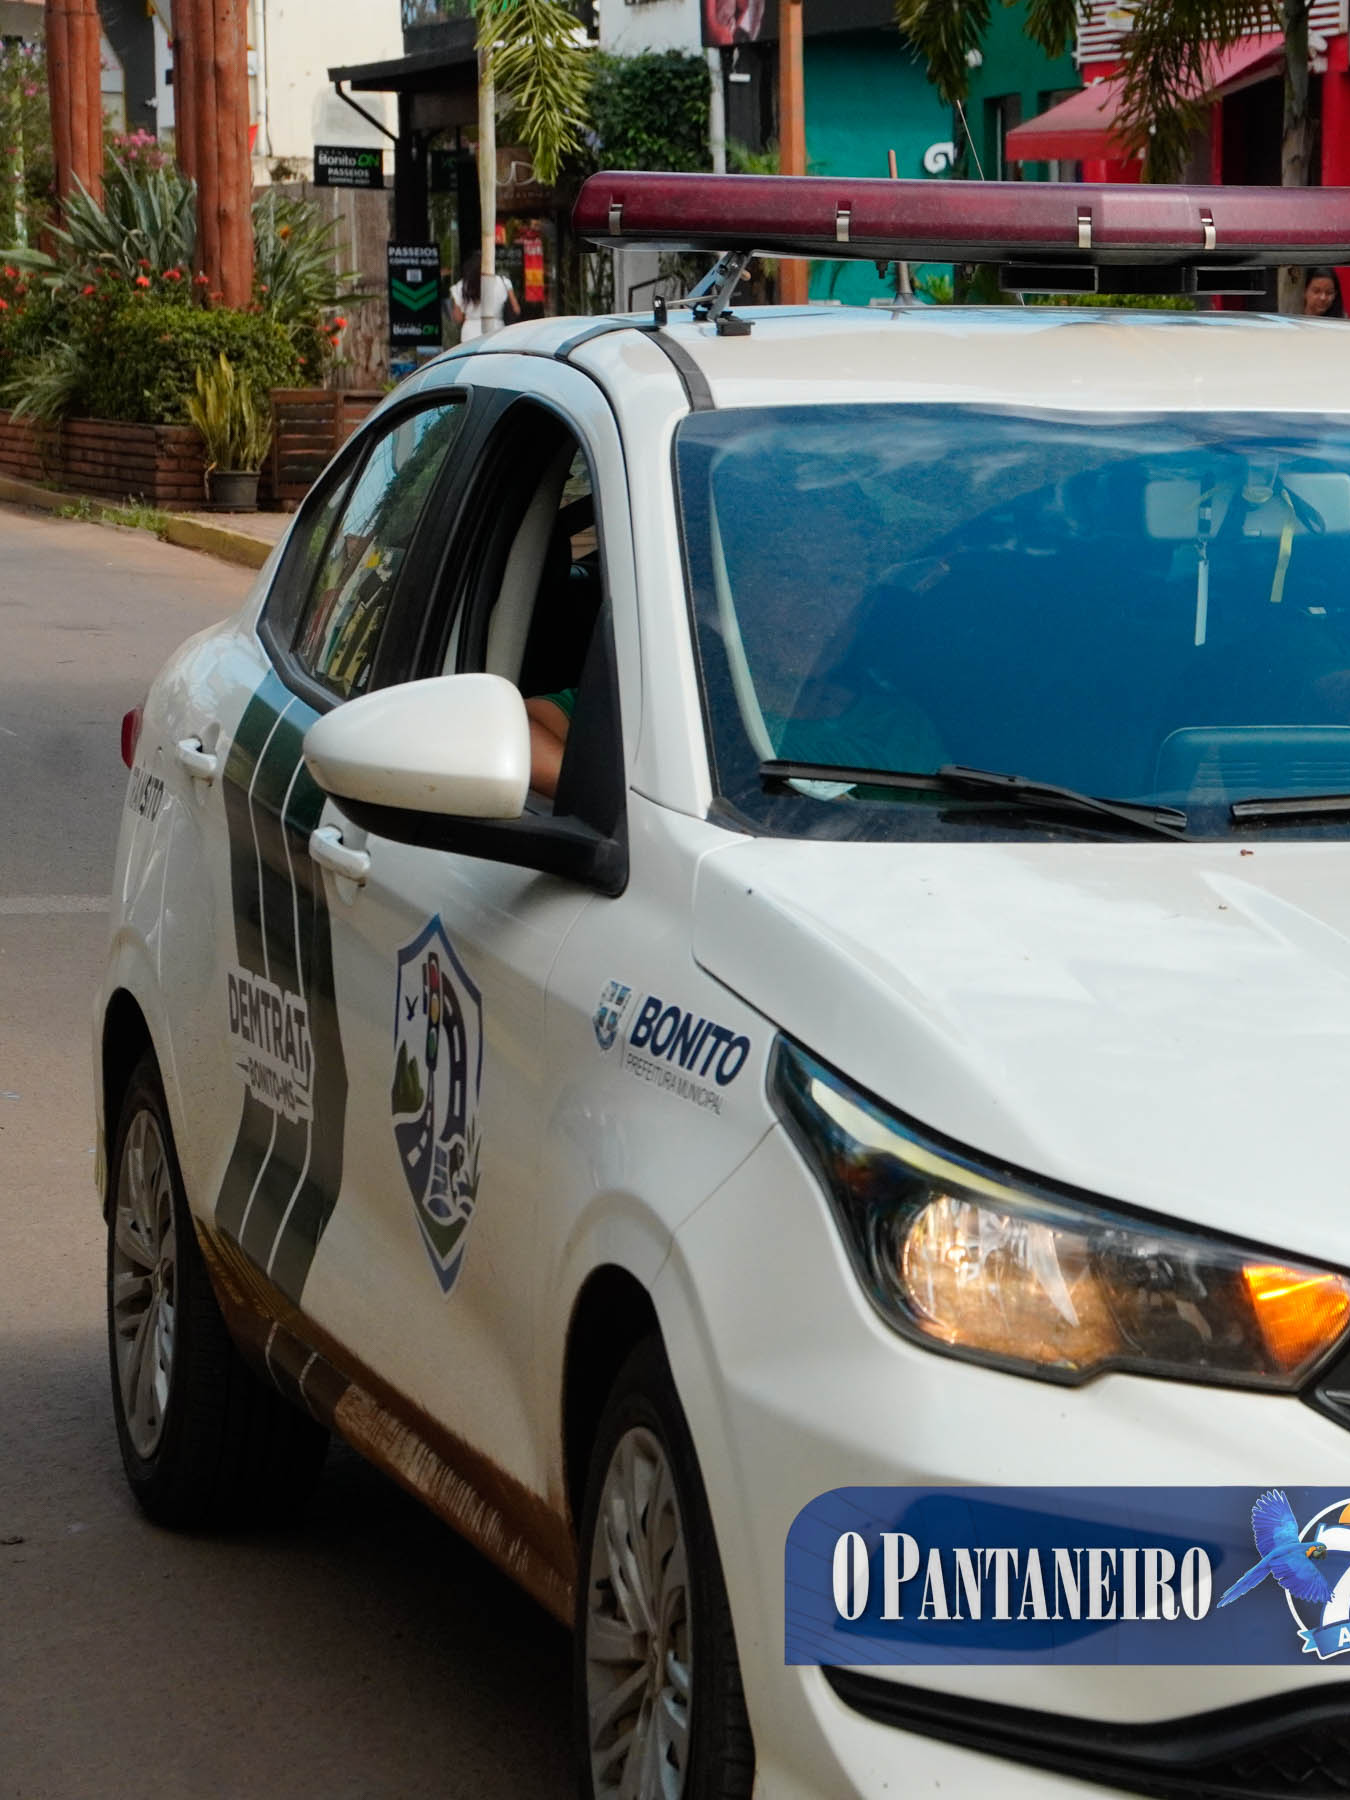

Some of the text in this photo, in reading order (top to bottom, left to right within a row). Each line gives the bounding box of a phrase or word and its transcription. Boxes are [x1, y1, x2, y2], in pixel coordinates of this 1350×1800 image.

[328, 168, 370, 178] PASSEIOS
[388, 246, 438, 257] PASSEIOS
[228, 973, 305, 1073] DEMTRAT
[629, 996, 751, 1087] BONITO
[625, 1053, 723, 1115] PREFEITURA MUNICIPAL
